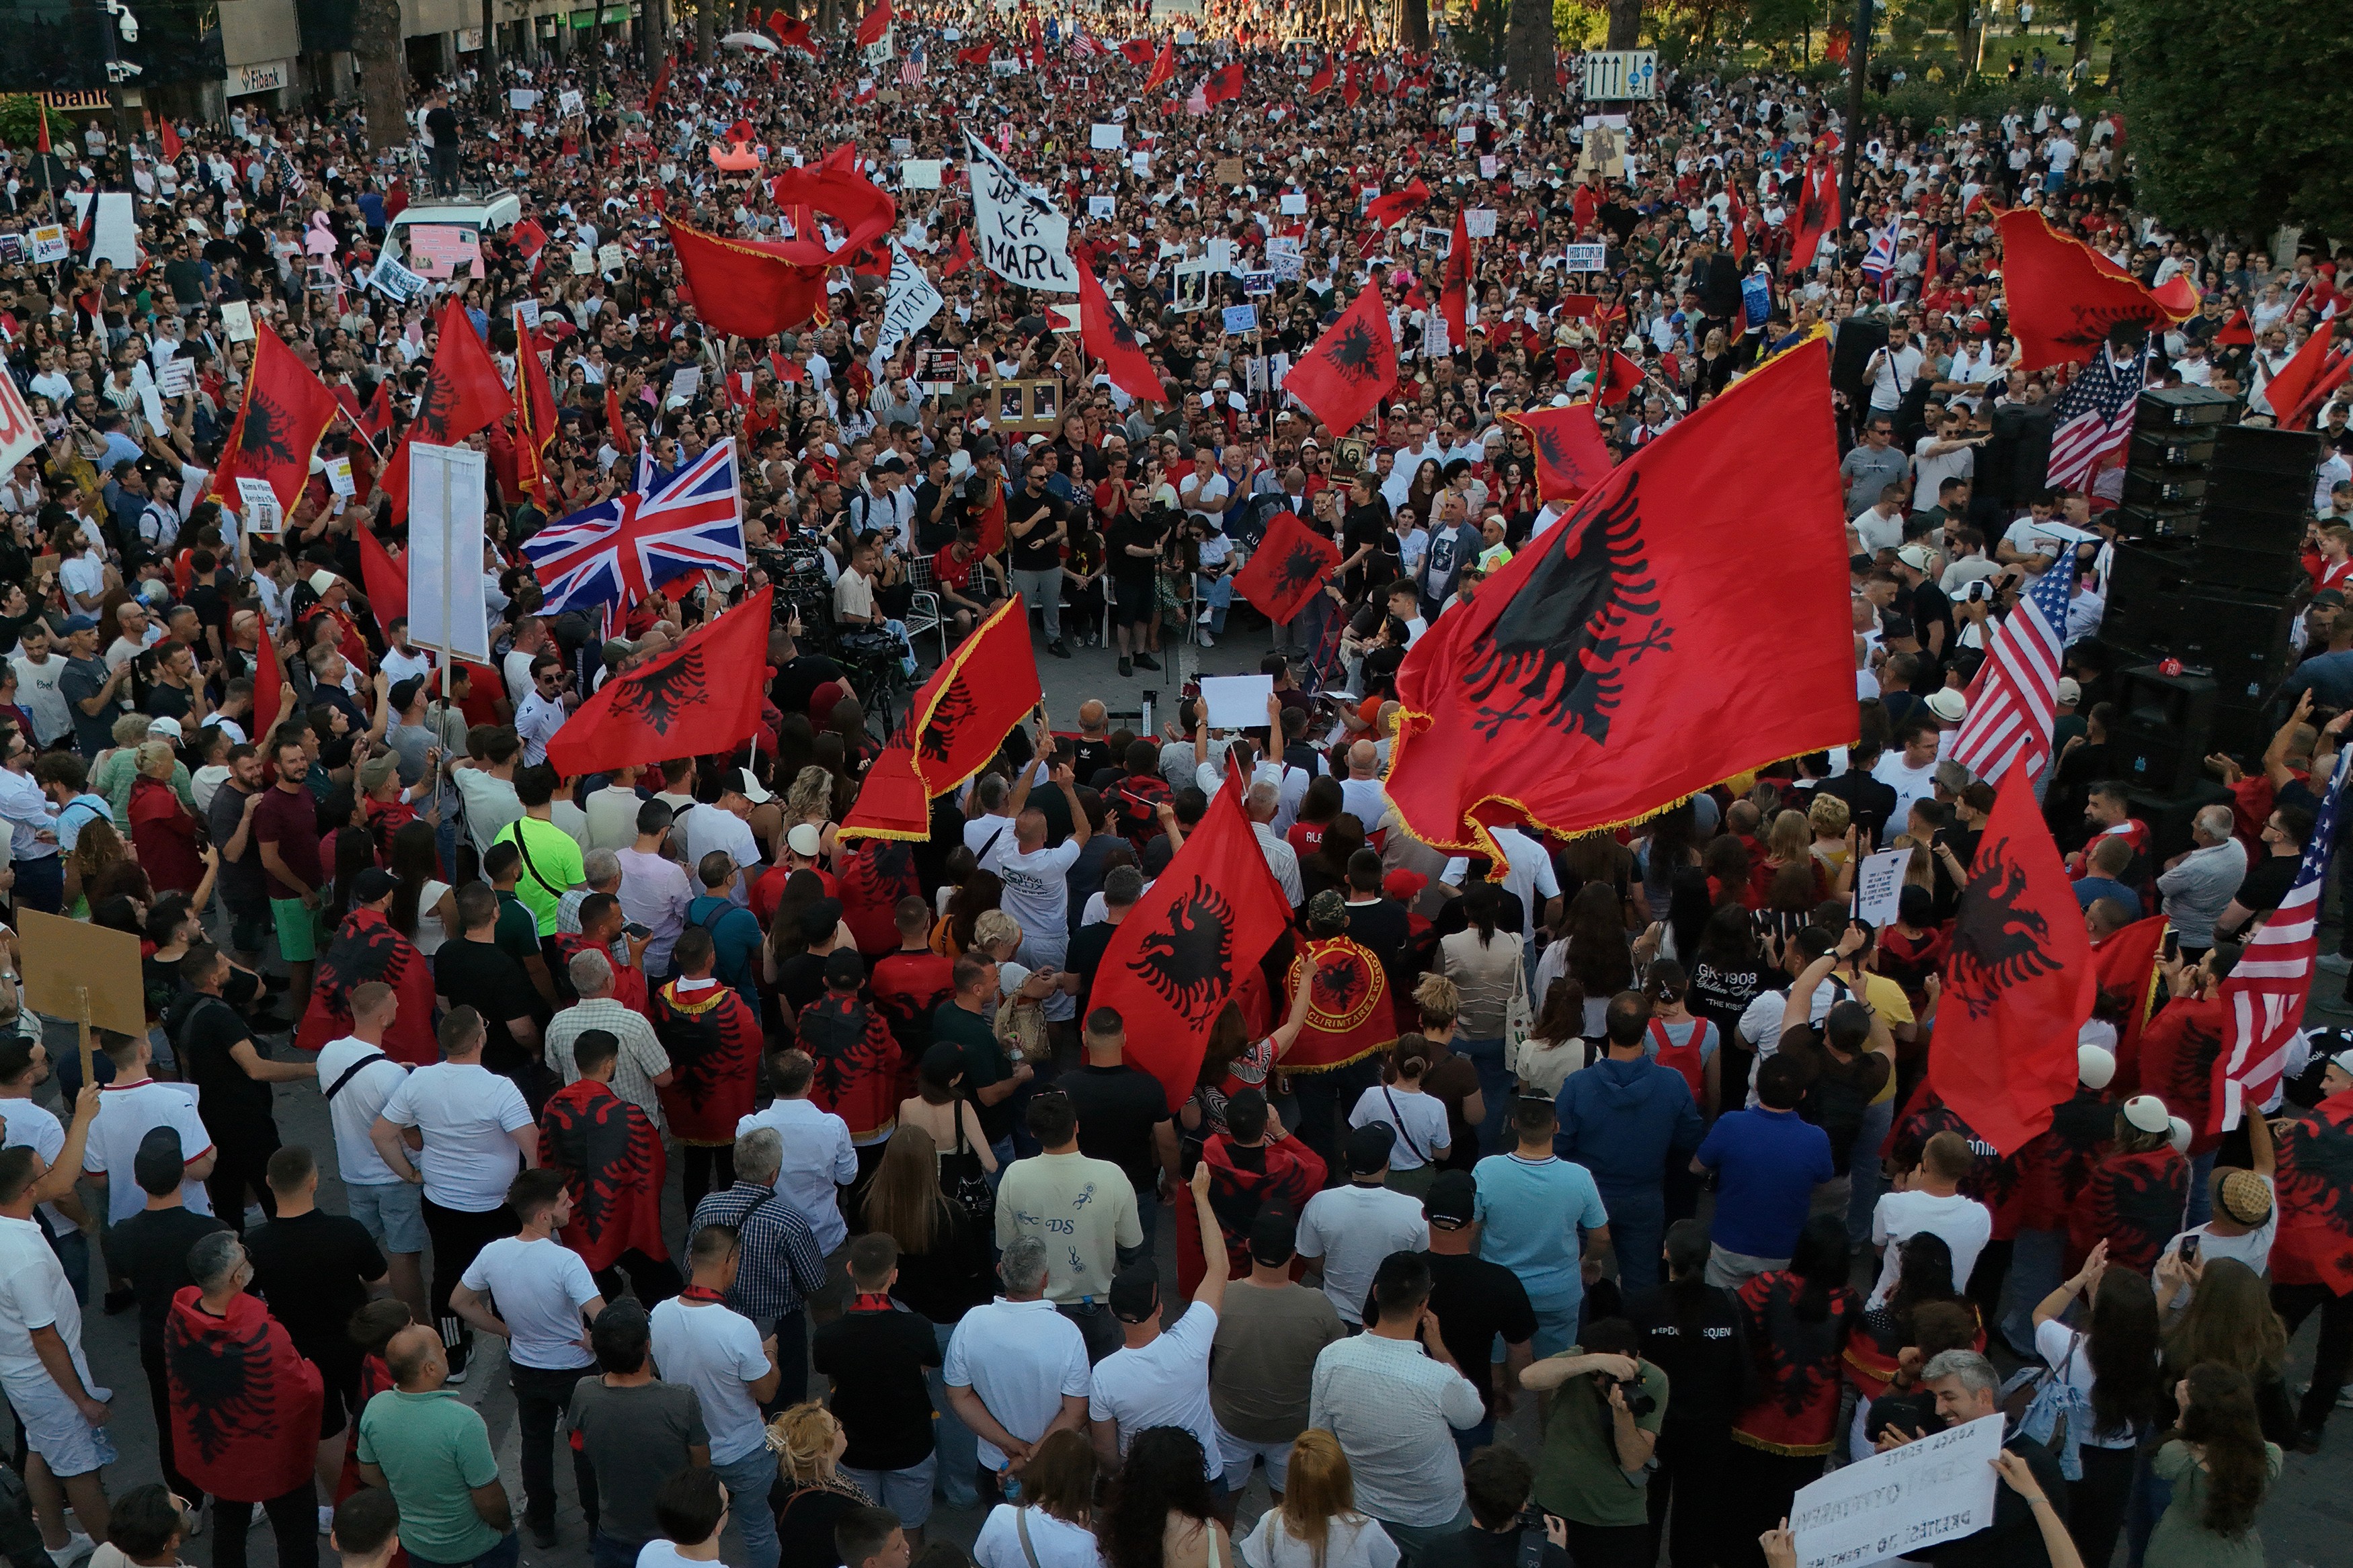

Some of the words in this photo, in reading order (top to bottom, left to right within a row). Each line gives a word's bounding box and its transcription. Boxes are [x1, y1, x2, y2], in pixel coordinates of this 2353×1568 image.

[251, 67, 280, 89] Fibank
[43, 90, 110, 108] ibank
[1569, 247, 1603, 259] HISTORIA
[241, 482, 257, 491] Rama
[245, 494, 266, 503] Berisha
[36, 679, 53, 690] Cool
[1022, 874, 1043, 884] TAXI
[1698, 963, 1757, 985] GK-1908
[1695, 973, 1728, 995] Golden
[1730, 984, 1757, 1001] Age
[1705, 998, 1724, 1007] "THE
[1725, 1001, 1745, 1011] KISS"
